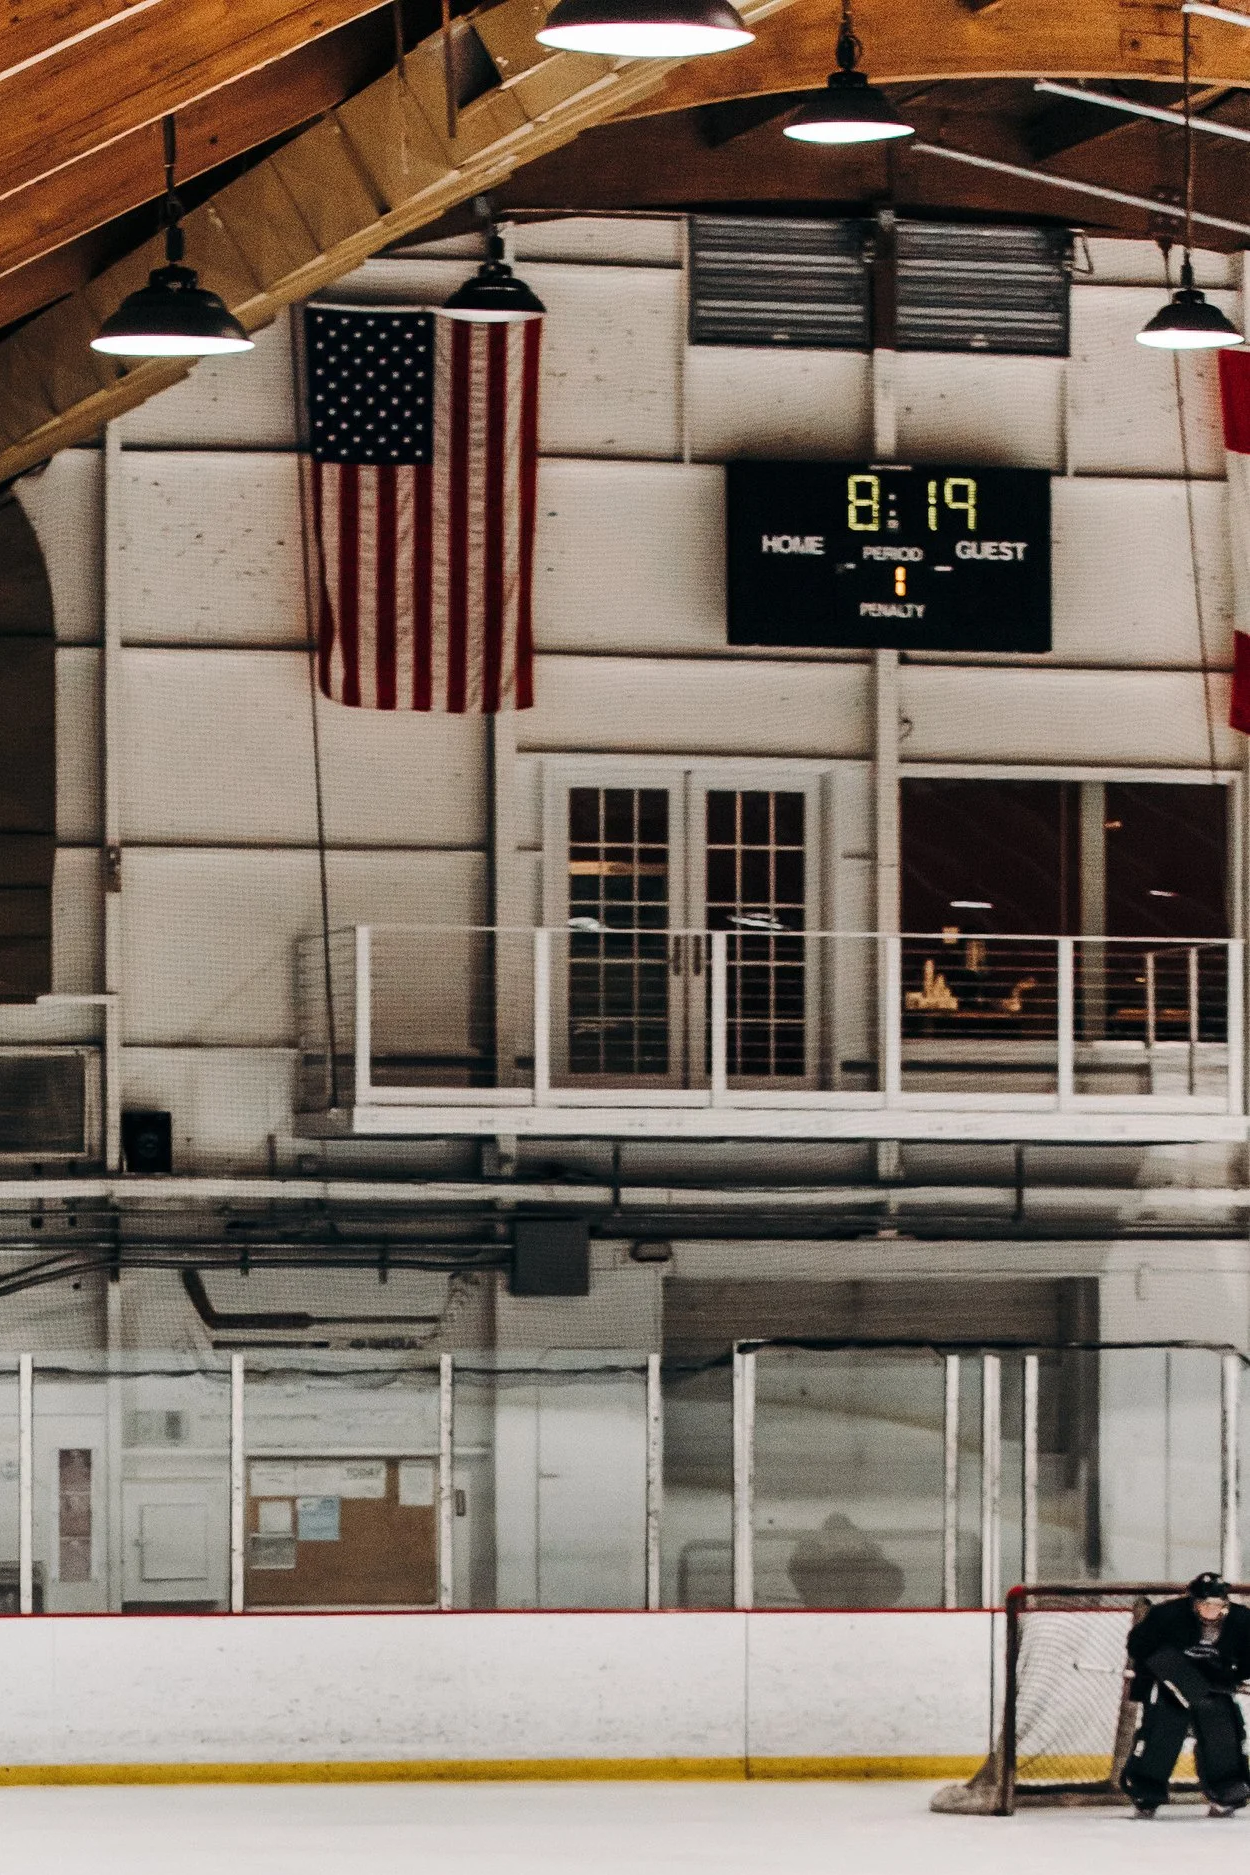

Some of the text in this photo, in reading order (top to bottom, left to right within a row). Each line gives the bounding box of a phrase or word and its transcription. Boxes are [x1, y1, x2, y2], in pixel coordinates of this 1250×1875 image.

[848, 474, 977, 531] 8:19
[761, 535, 827, 555] HOME
[862, 546, 925, 562] PERIOD
[955, 540, 1029, 561] GUEST
[894, 566, 907, 596] 1
[859, 603, 926, 619] PENALTY
